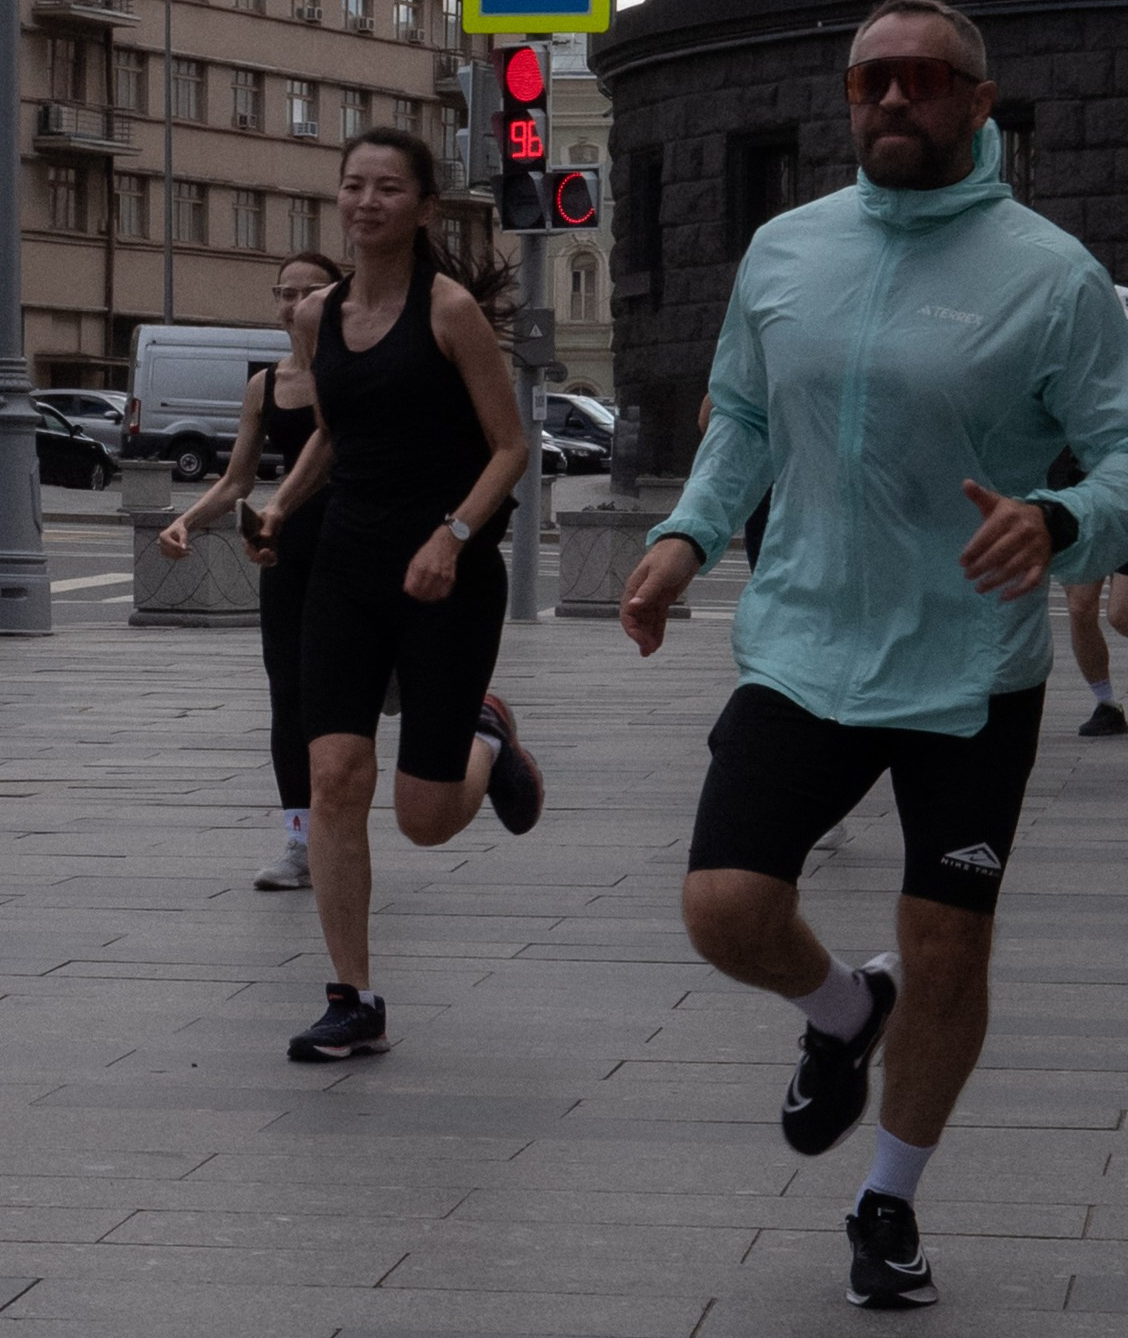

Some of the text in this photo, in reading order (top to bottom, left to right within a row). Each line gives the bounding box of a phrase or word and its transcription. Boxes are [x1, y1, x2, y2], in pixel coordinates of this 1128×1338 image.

[510, 120, 544, 159] 96
[934, 307, 984, 326] TERREX
[940, 856, 971, 872] NIKE
